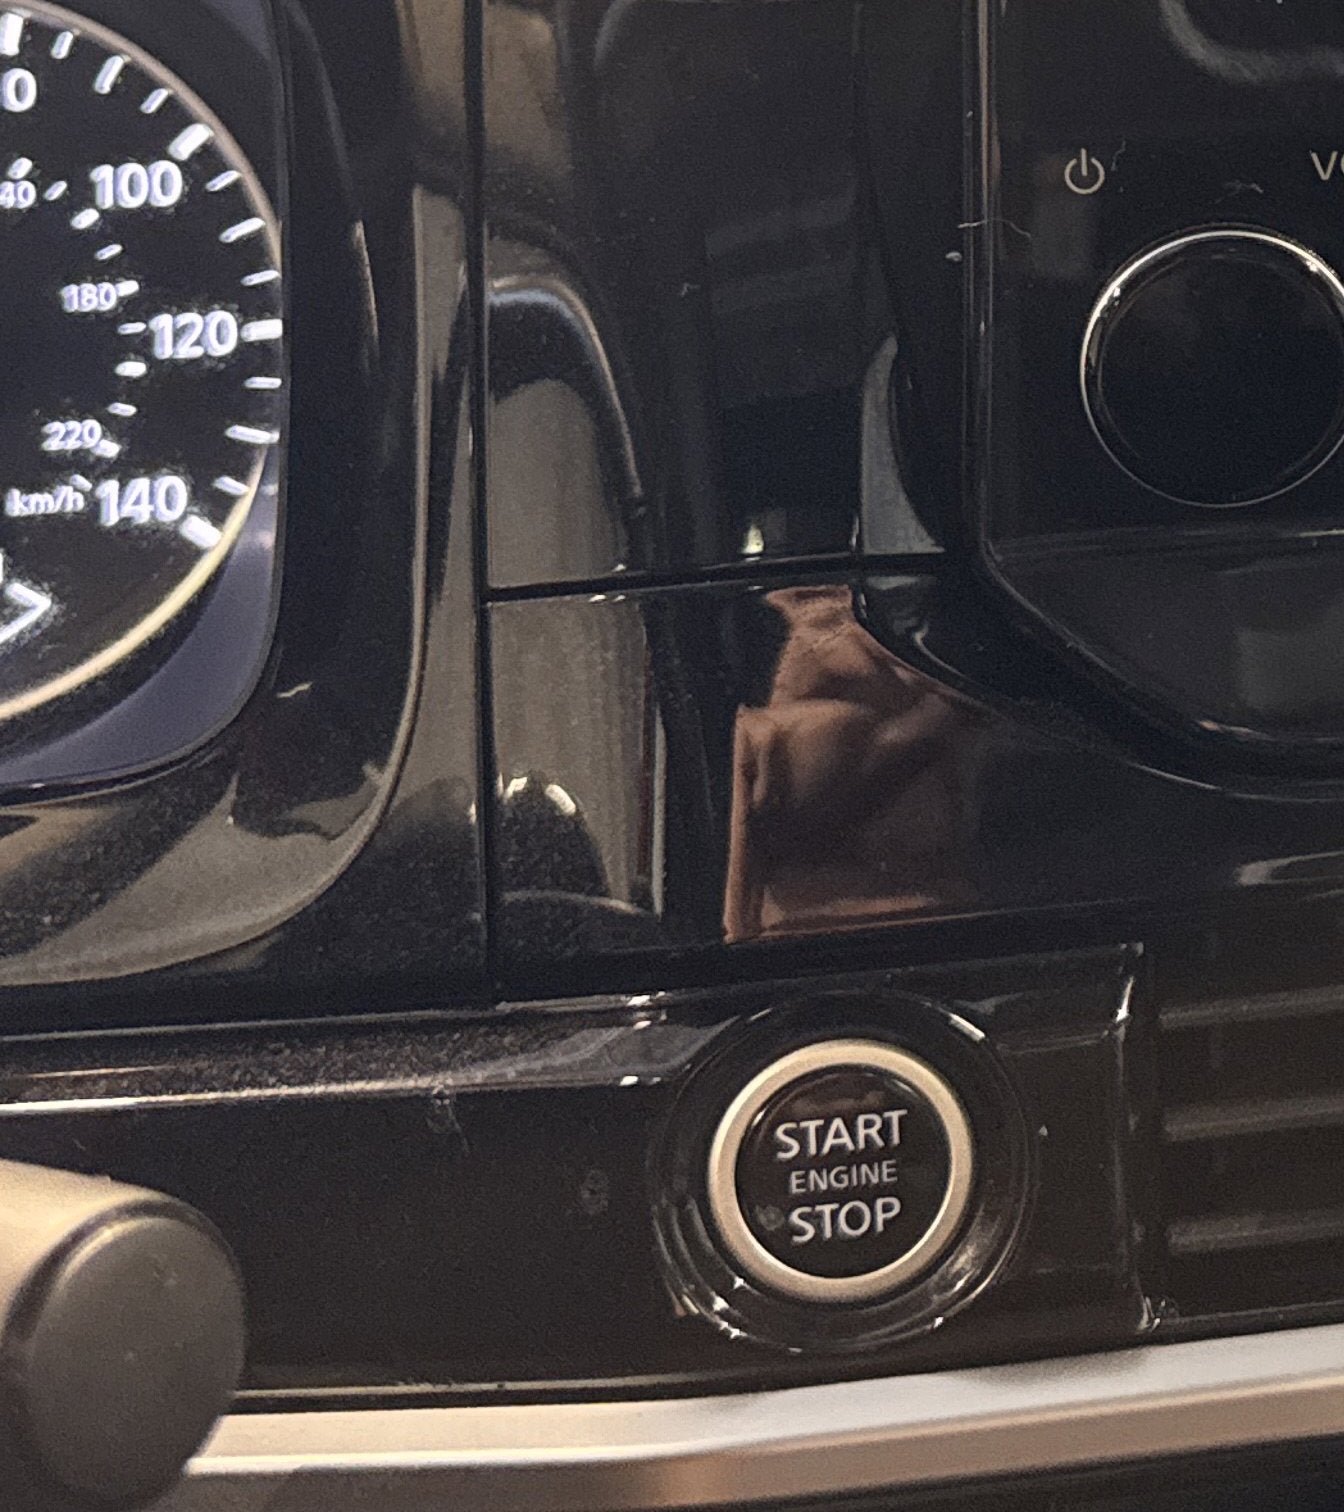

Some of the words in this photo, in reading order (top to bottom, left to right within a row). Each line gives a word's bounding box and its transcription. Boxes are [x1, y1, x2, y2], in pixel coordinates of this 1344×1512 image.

[90, 161, 183, 210] 100
[60, 280, 117, 312] 180
[148, 309, 239, 360] 120
[42, 418, 101, 450] 220
[5, 485, 85, 517] km/h
[95, 475, 188, 527] 140
[775, 1109, 907, 1160] START
[789, 1159, 898, 1194] ENGINE
[788, 1196, 902, 1243] STOP
